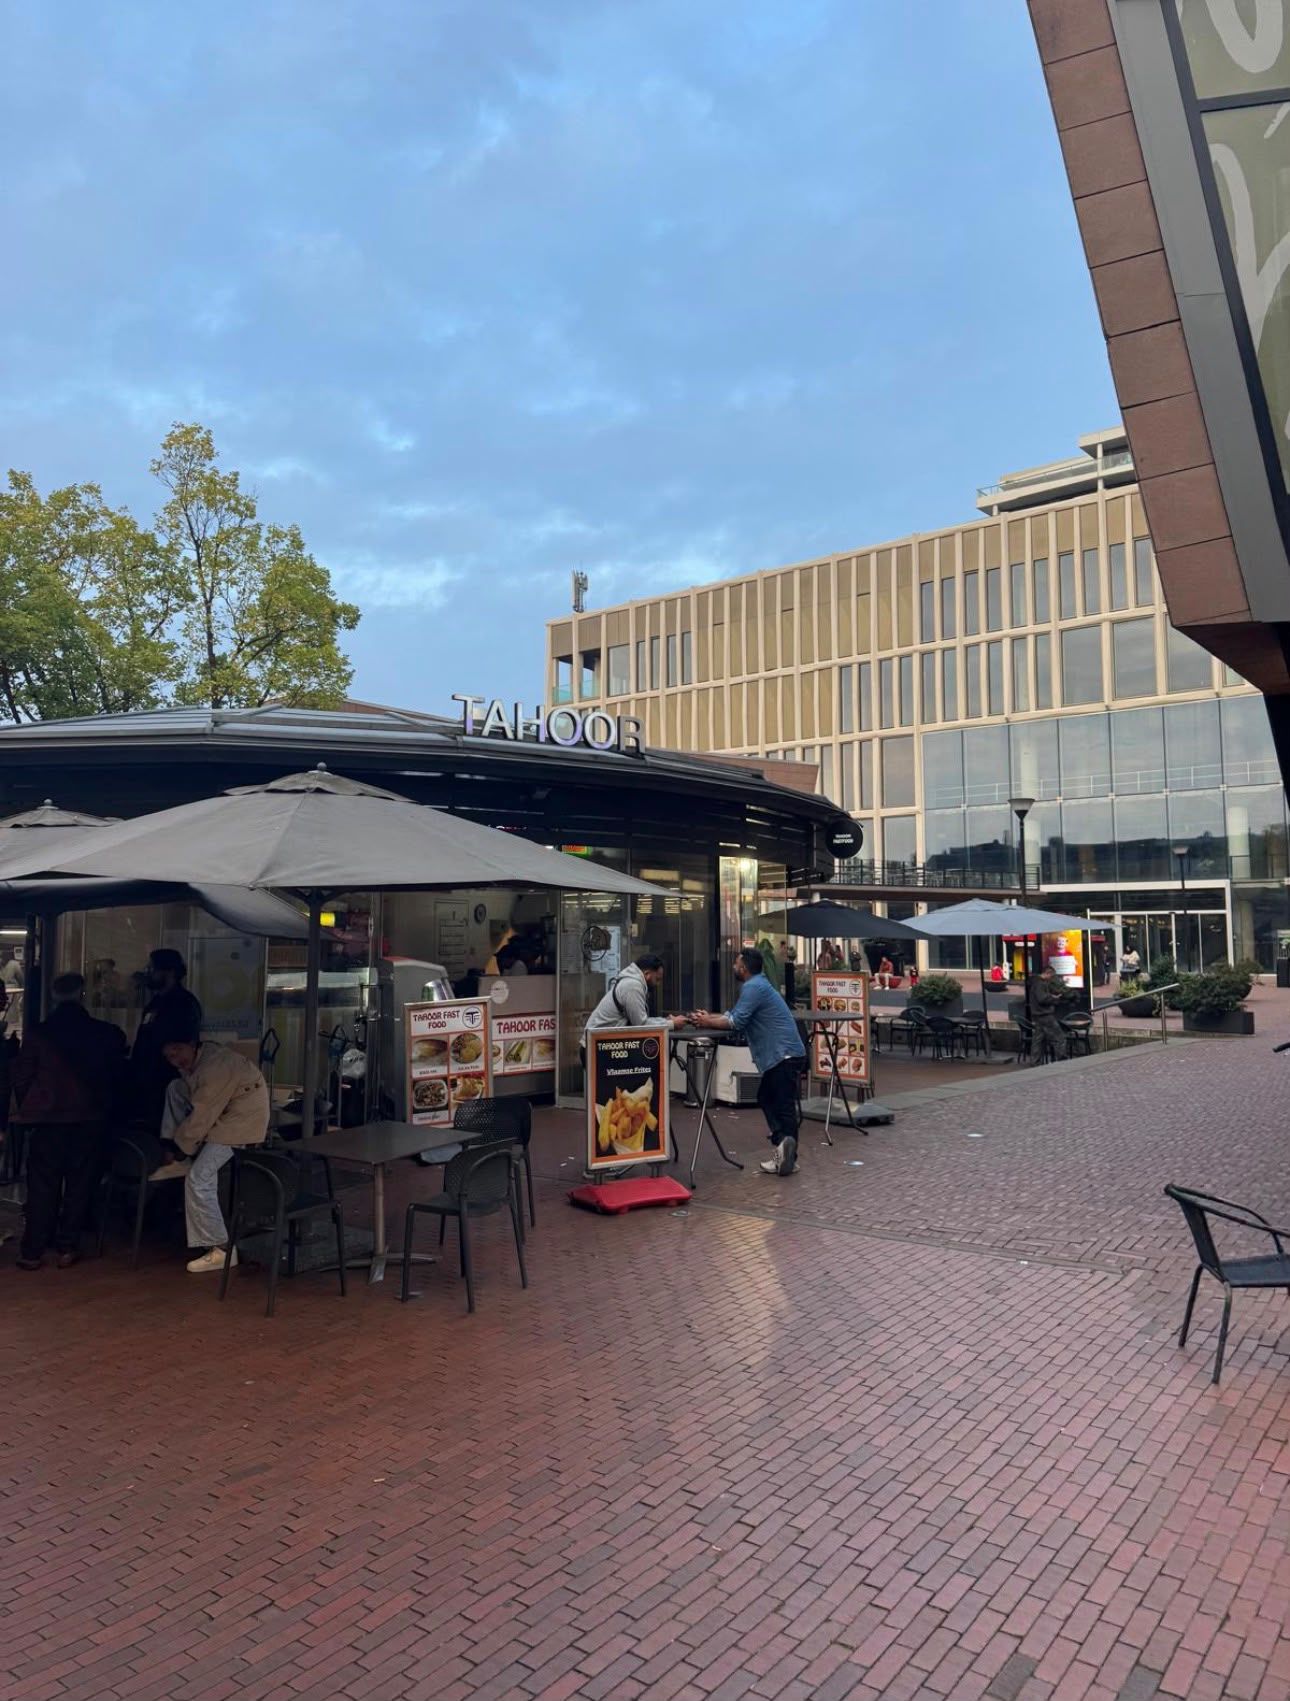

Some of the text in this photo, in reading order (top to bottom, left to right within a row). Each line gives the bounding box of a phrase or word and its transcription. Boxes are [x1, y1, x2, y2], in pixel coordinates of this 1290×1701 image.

[452, 693, 646, 756] TAHOOR
[413, 1010, 460, 1022] TAHOOR FAST
[428, 1020, 447, 1029] FOOD
[497, 1019, 537, 1034] TAHOOR
[597, 1041, 640, 1051] TAHOOR FAST
